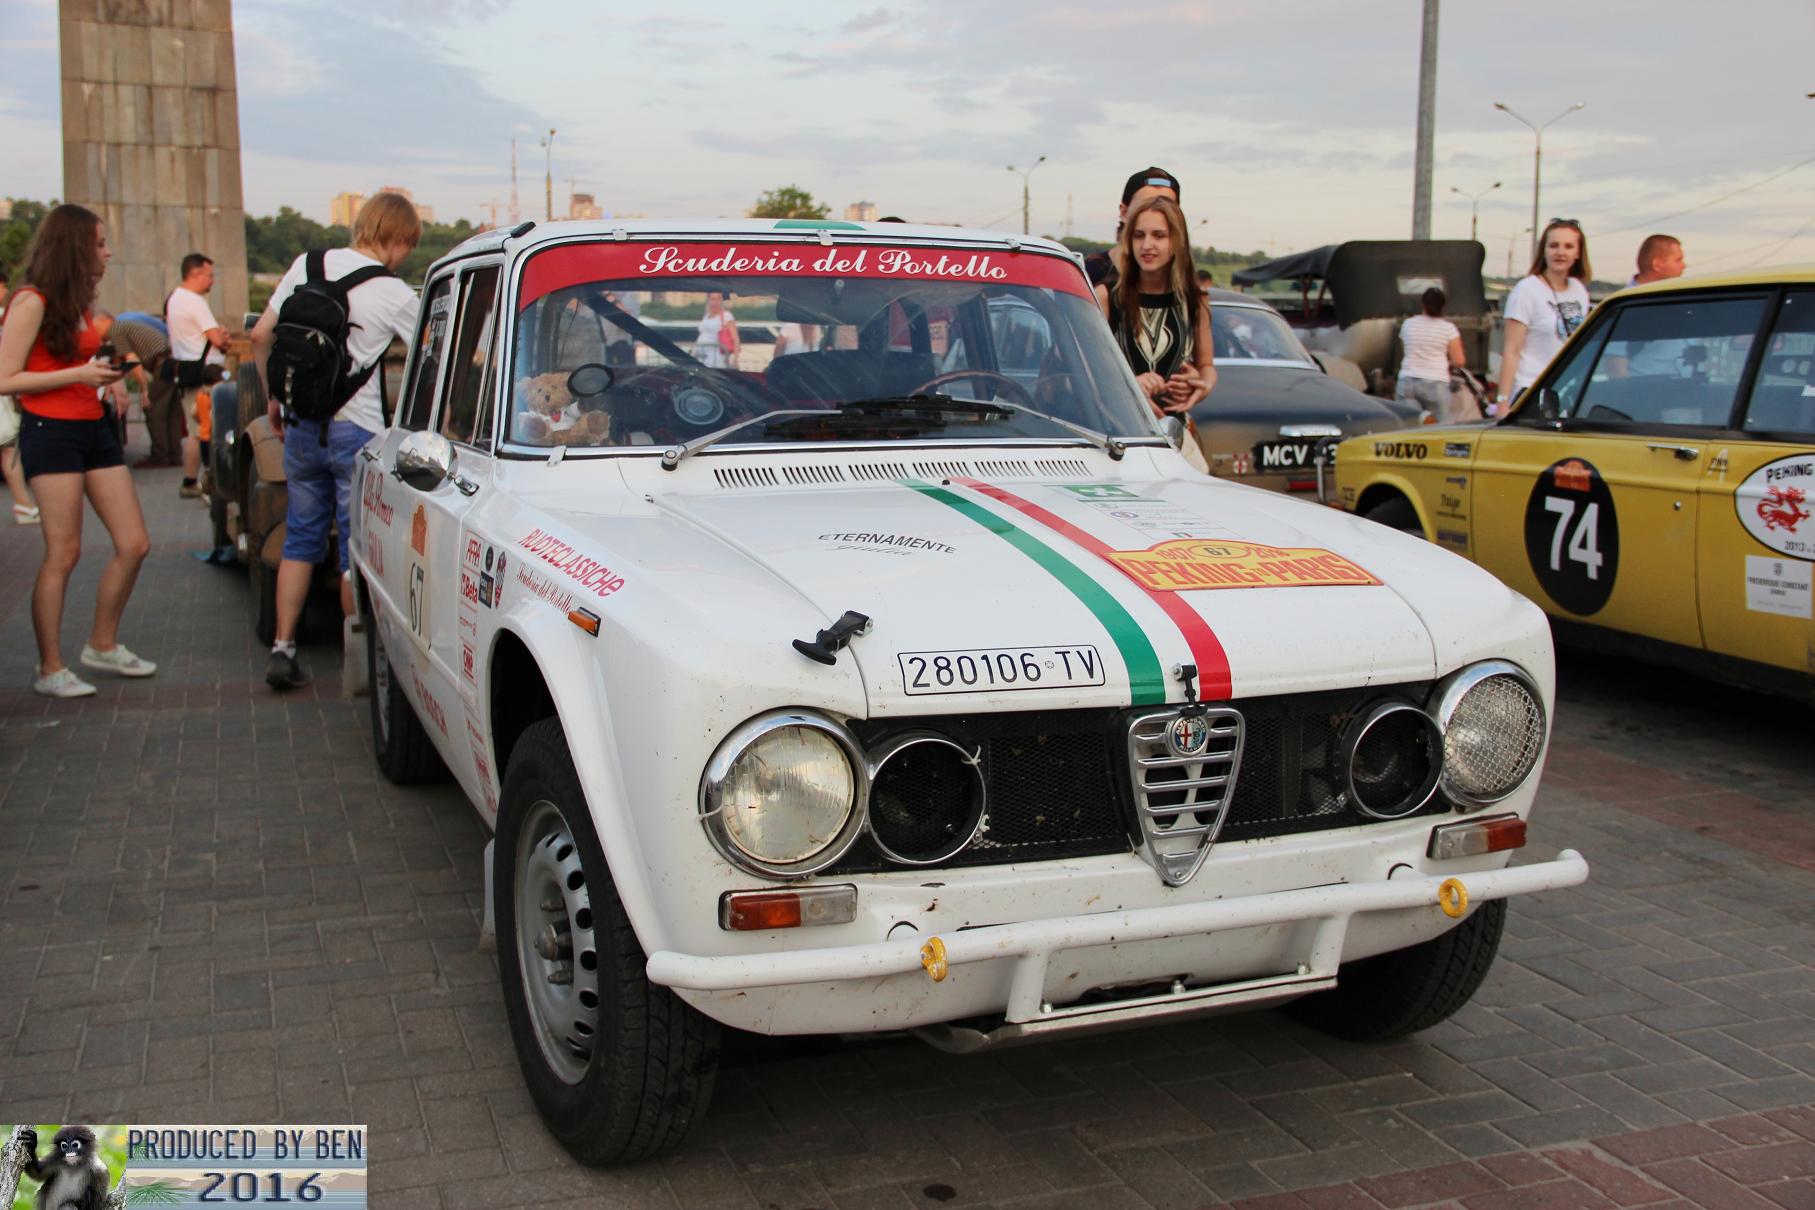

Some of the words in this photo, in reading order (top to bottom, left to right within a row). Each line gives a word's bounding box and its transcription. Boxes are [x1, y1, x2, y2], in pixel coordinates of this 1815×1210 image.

[638, 246, 804, 275] Scuderia
[811, 248, 867, 274] del
[878, 248, 1008, 280] Portello
[1262, 444, 1309, 467] MCV
[1374, 441, 1428, 460] VOLVO
[1766, 463, 1814, 484] PEKING
[1203, 546, 1232, 556] 67
[1544, 495, 1604, 581] 74
[1121, 557, 1264, 586] PEKING
[1257, 555, 1368, 582] PARIS
[409, 561, 425, 637] 67
[465, 576, 479, 606] Beta
[908, 651, 1041, 688] 280106
[1054, 649, 1096, 681] TV
